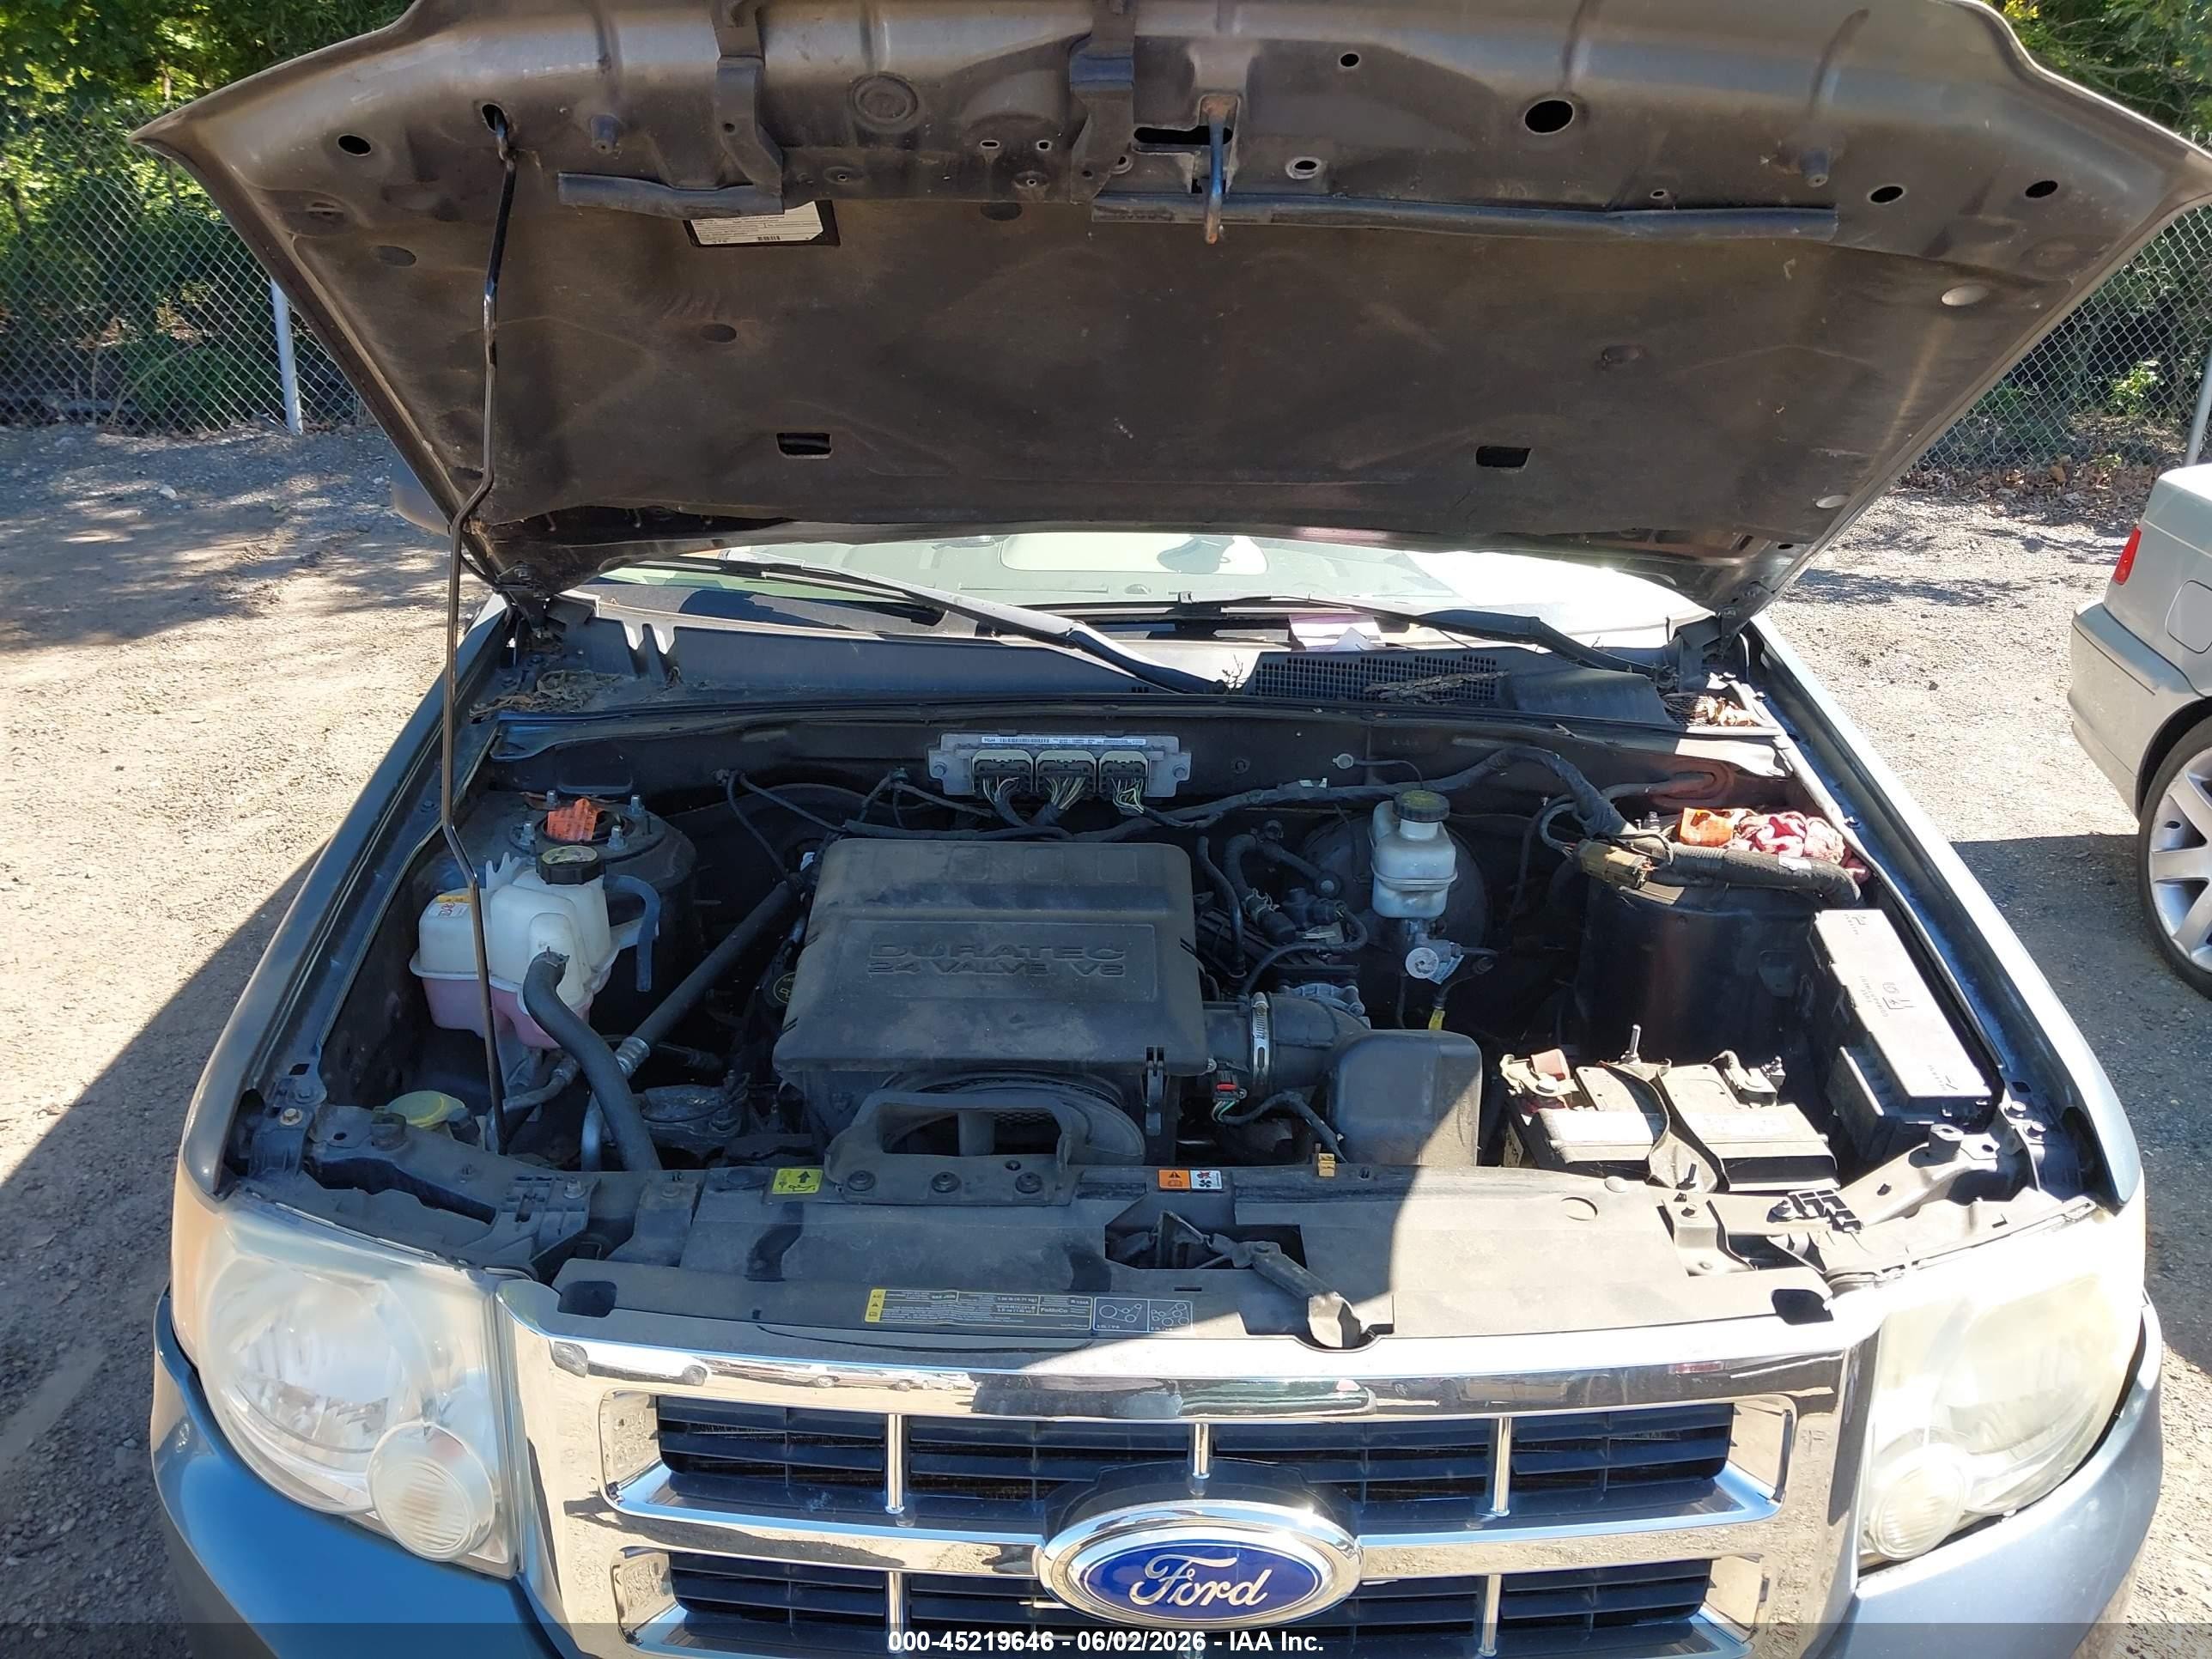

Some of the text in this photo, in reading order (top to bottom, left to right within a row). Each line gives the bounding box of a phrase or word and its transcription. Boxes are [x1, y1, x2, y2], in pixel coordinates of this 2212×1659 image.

[868, 945, 1126, 961] DURATEC
[867, 961, 921, 974] 24
[929, 961, 1048, 976] VALVE
[1128, 1553, 1273, 1607] Ford
